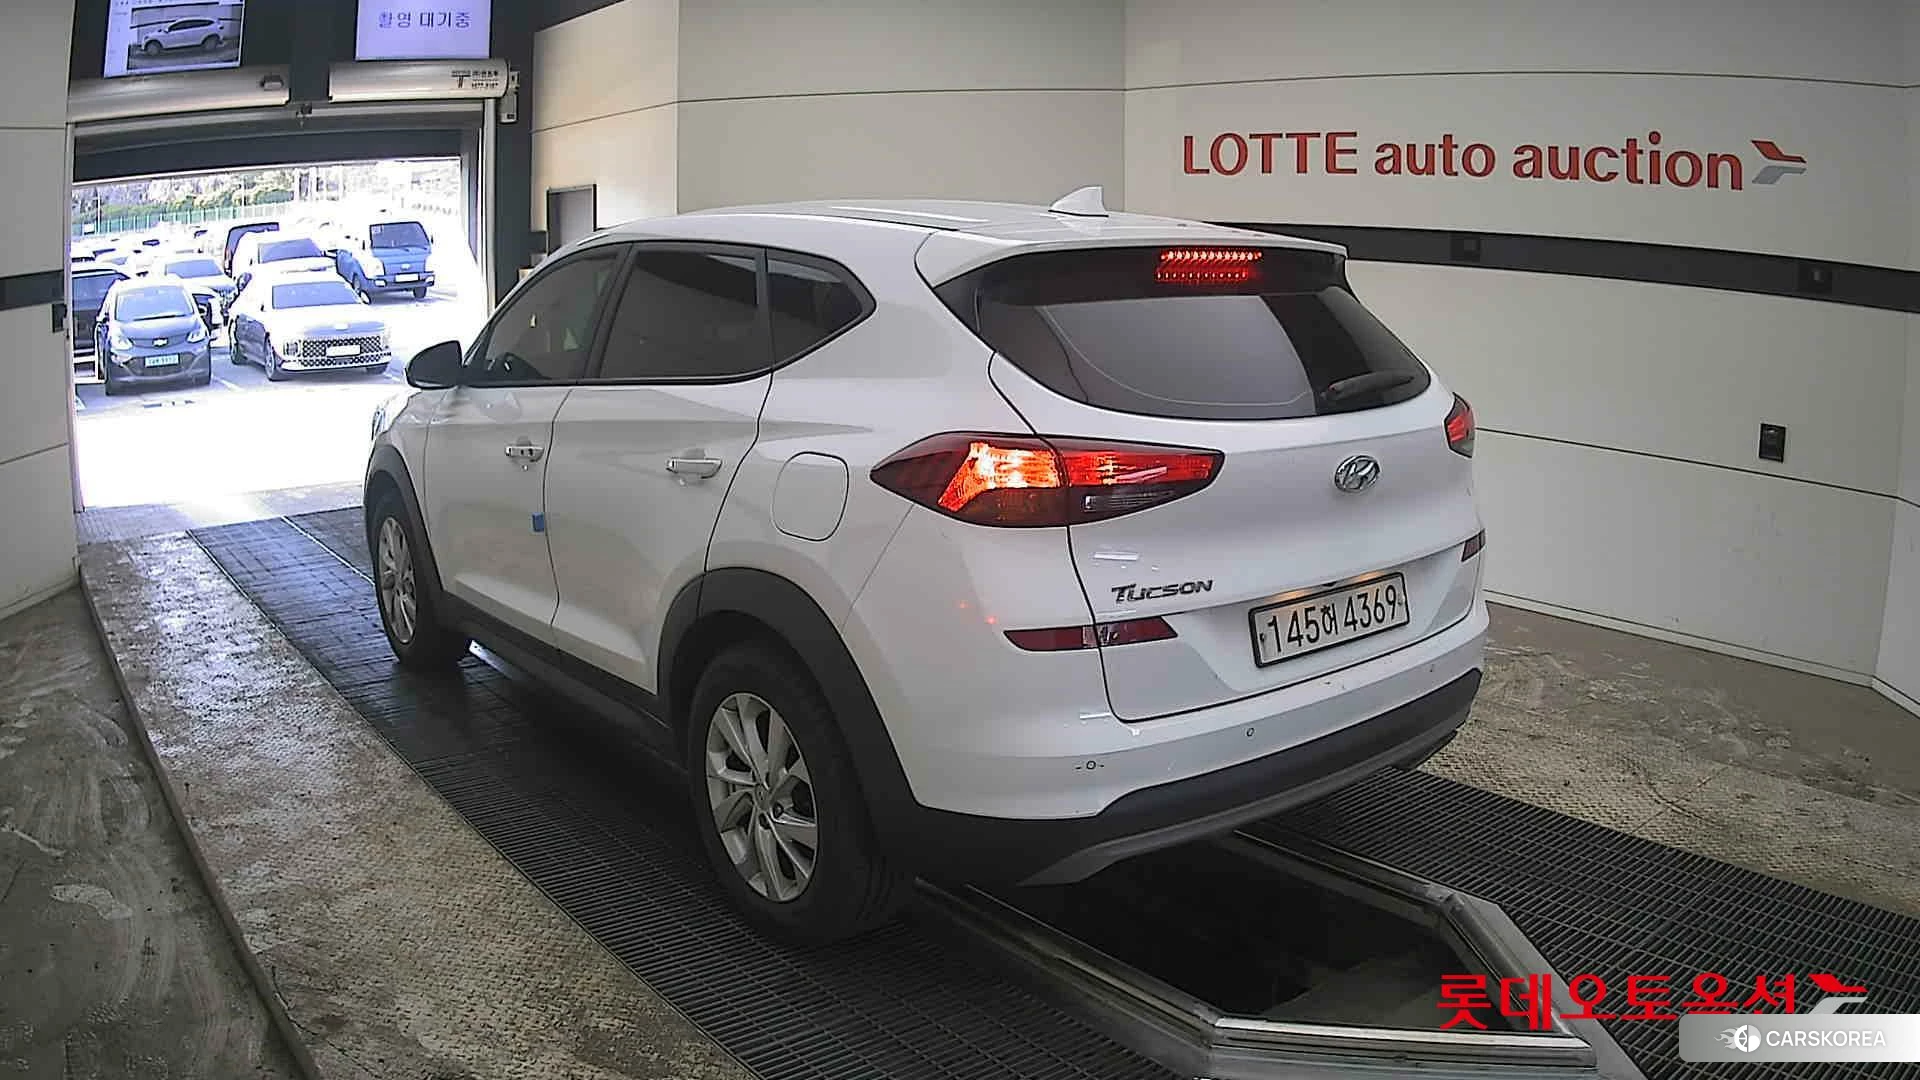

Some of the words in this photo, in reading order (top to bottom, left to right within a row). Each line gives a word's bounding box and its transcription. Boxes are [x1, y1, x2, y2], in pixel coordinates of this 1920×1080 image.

[1184, 131, 1359, 176] LOTTE
[1375, 133, 1496, 178] auto
[1513, 131, 1743, 190] auction
[1268, 603, 1339, 653] 145허
[1343, 584, 1397, 632] 4369
